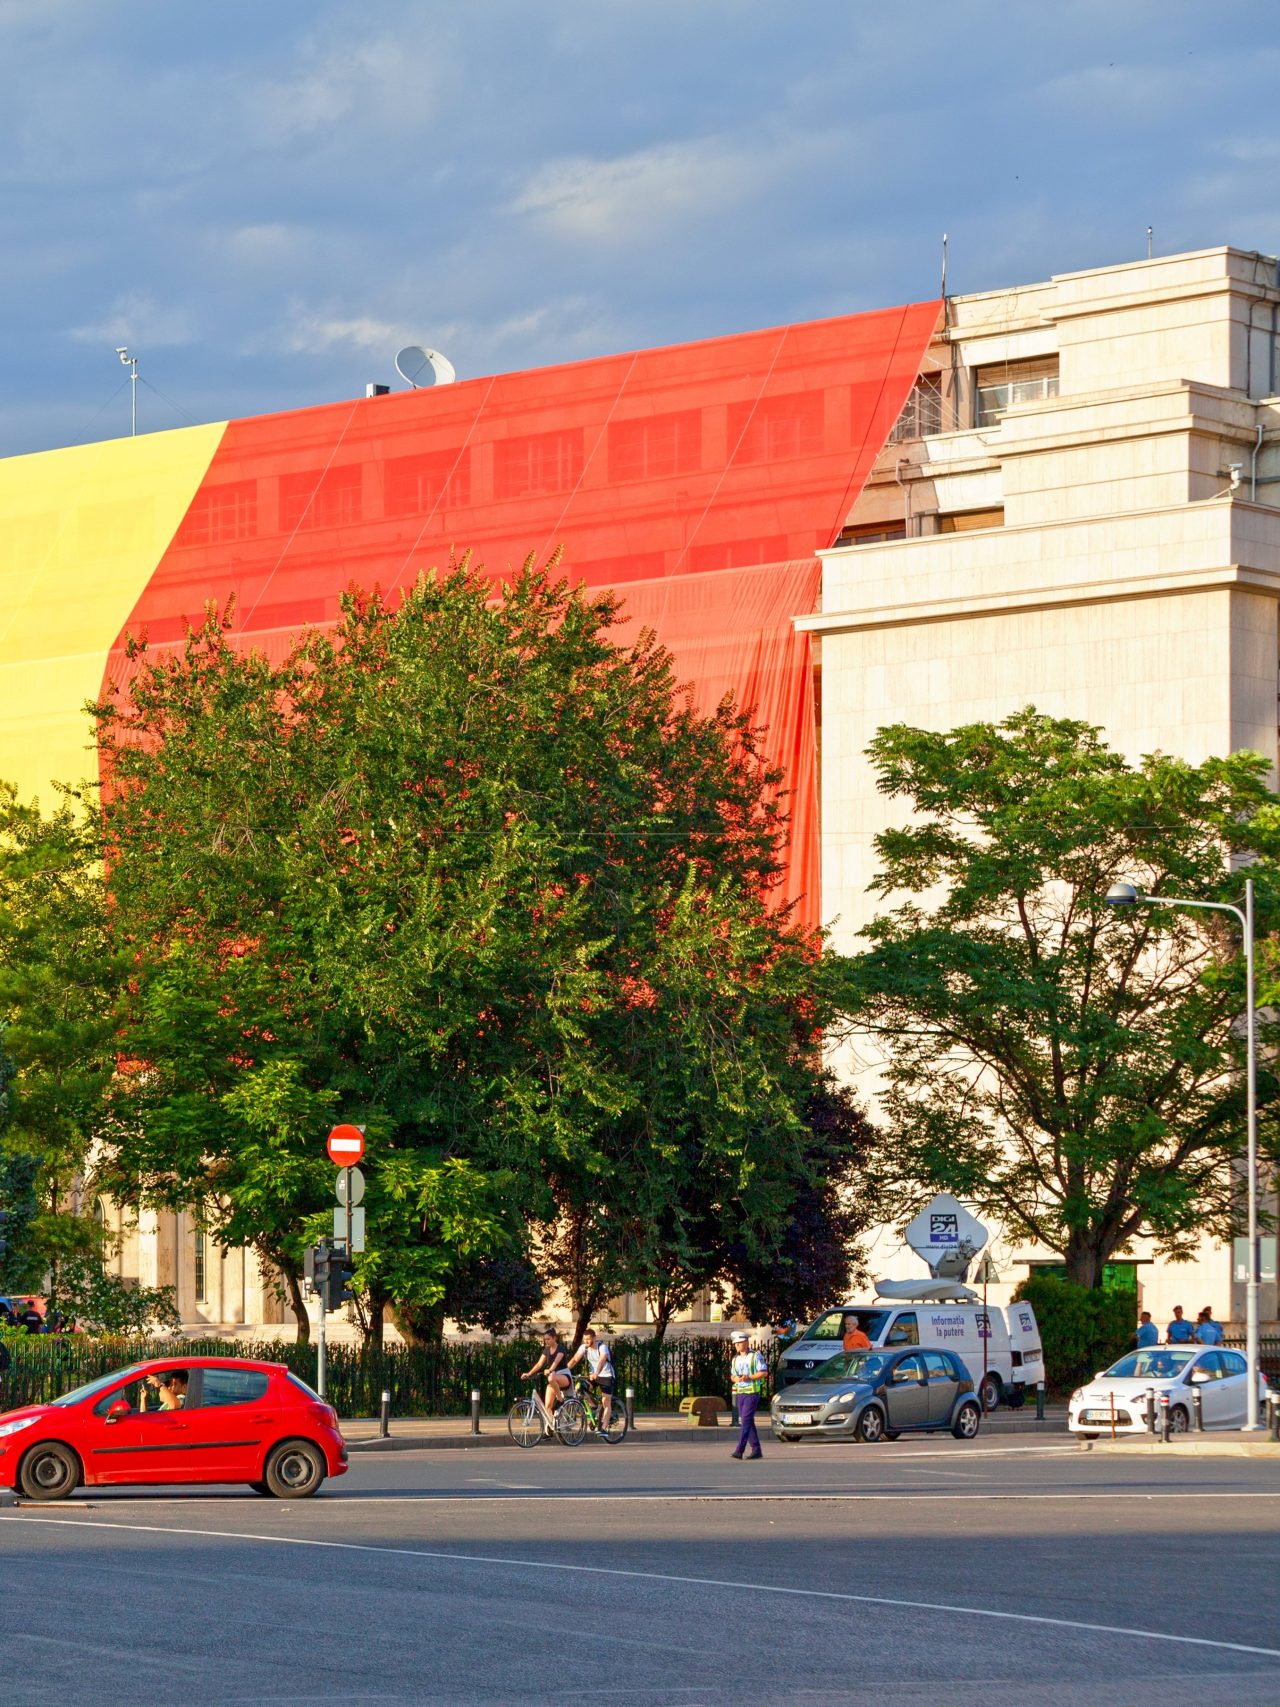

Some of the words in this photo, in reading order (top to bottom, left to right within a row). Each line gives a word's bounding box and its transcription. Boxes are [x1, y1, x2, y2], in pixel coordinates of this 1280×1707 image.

[932, 1222, 958, 1238] 24
[936, 1327, 942, 1337] la
[943, 1328, 964, 1339] putere
